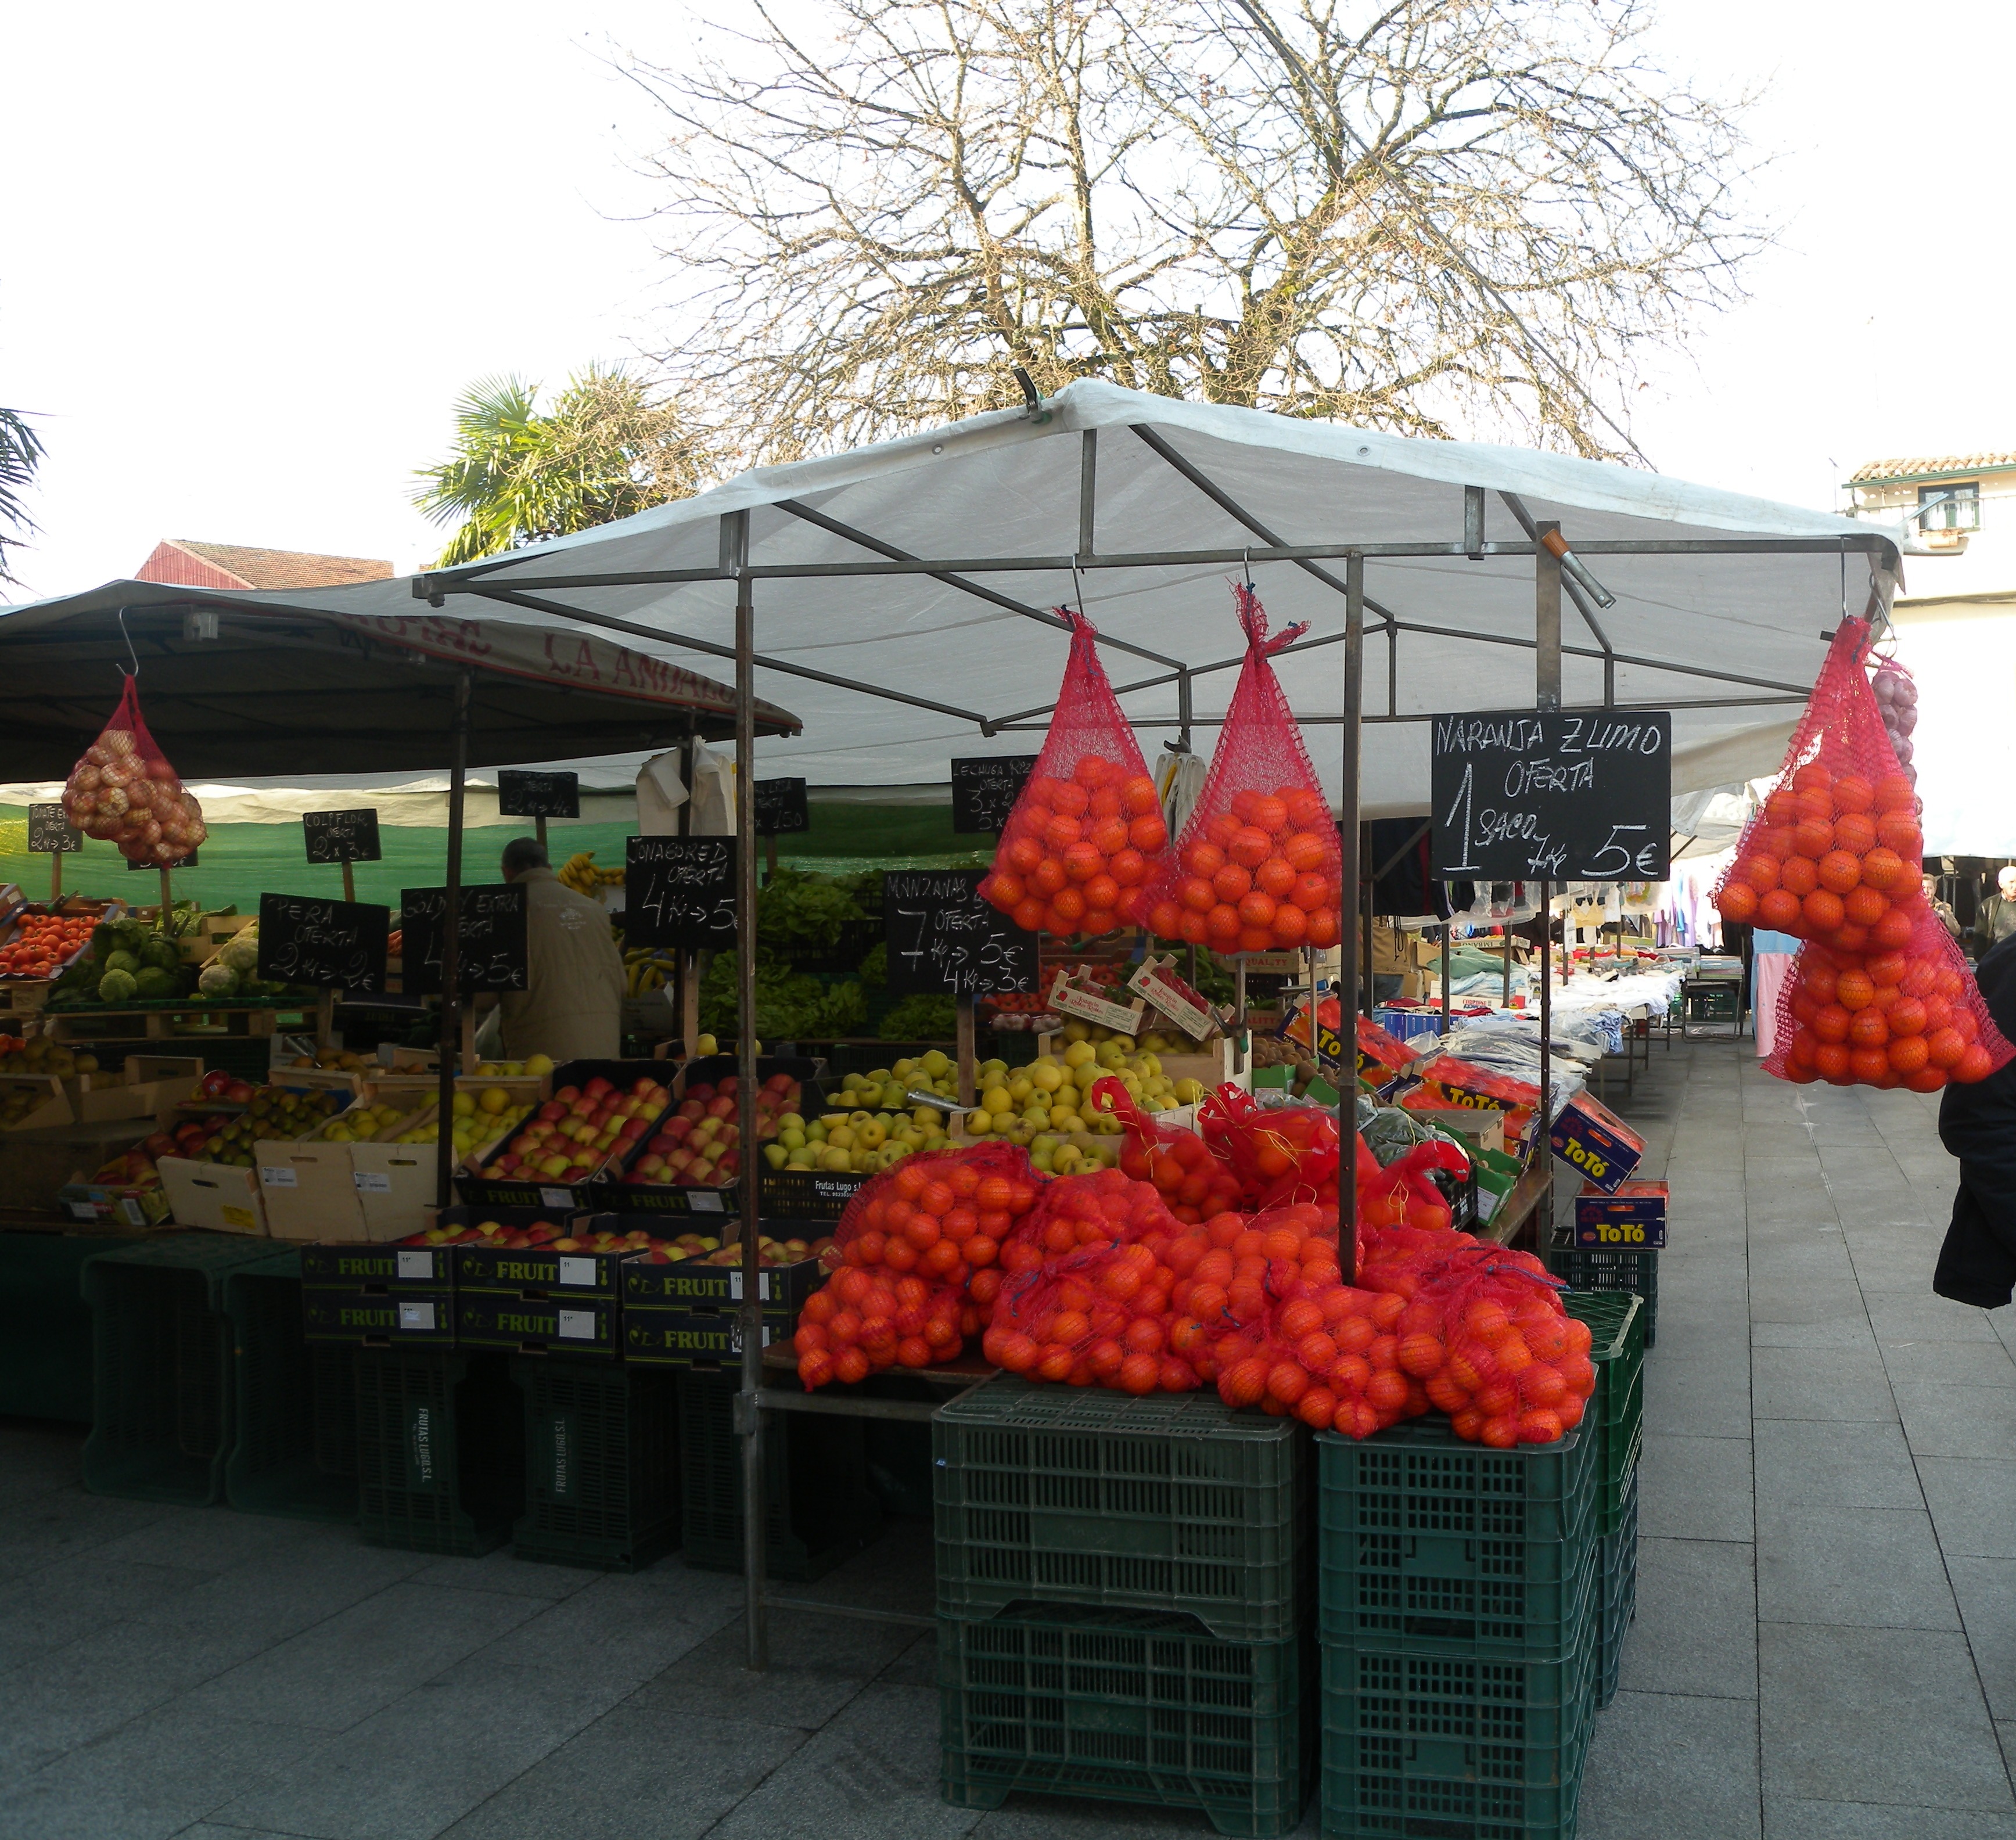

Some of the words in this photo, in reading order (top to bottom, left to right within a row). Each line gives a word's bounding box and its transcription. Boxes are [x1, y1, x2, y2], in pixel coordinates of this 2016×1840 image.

[544, 631, 601, 682] LA
[1437, 716, 1543, 755] NARANJA
[1561, 718, 1661, 755] ZUMO
[953, 761, 1003, 776] LECHUGA
[1505, 757, 1594, 797] OFERTA
[980, 778, 1013, 790] OFERTA
[508, 789, 524, 813] 2
[966, 789, 983, 812] 3
[978, 811, 991, 829] 5
[1443, 762, 1482, 871] 1
[31, 827, 44, 850] 2
[312, 836, 331, 859] 2
[1580, 824, 1659, 876] 5€
[668, 862, 728, 886] OFERTA
[268, 898, 333, 924] PERA
[476, 892, 519, 913] EXTRA
[642, 874, 664, 928] 4
[935, 909, 989, 930] OFERTA
[294, 925, 359, 947] OFERTA
[897, 908, 927, 972] 7
[269, 942, 299, 977] 2
[424, 931, 445, 981] 4
[944, 959, 958, 994] 4
[487, 1189, 541, 1206] FRUIT
[815, 1180, 835, 1190] Frutas
[836, 1181, 851, 1193] Lugo
[632, 1194, 688, 1210] FRUIT
[338, 1258, 396, 1275] FRUIT
[497, 1262, 557, 1282] FRUIT
[664, 1278, 728, 1297] FRUIT
[340, 1309, 397, 1327] FRUIT
[497, 1313, 556, 1334] FRUIT
[665, 1331, 728, 1350] FRUIT
[418, 1408, 429, 1442] FRUTAS
[555, 1459, 567, 1493] FRUTAS
